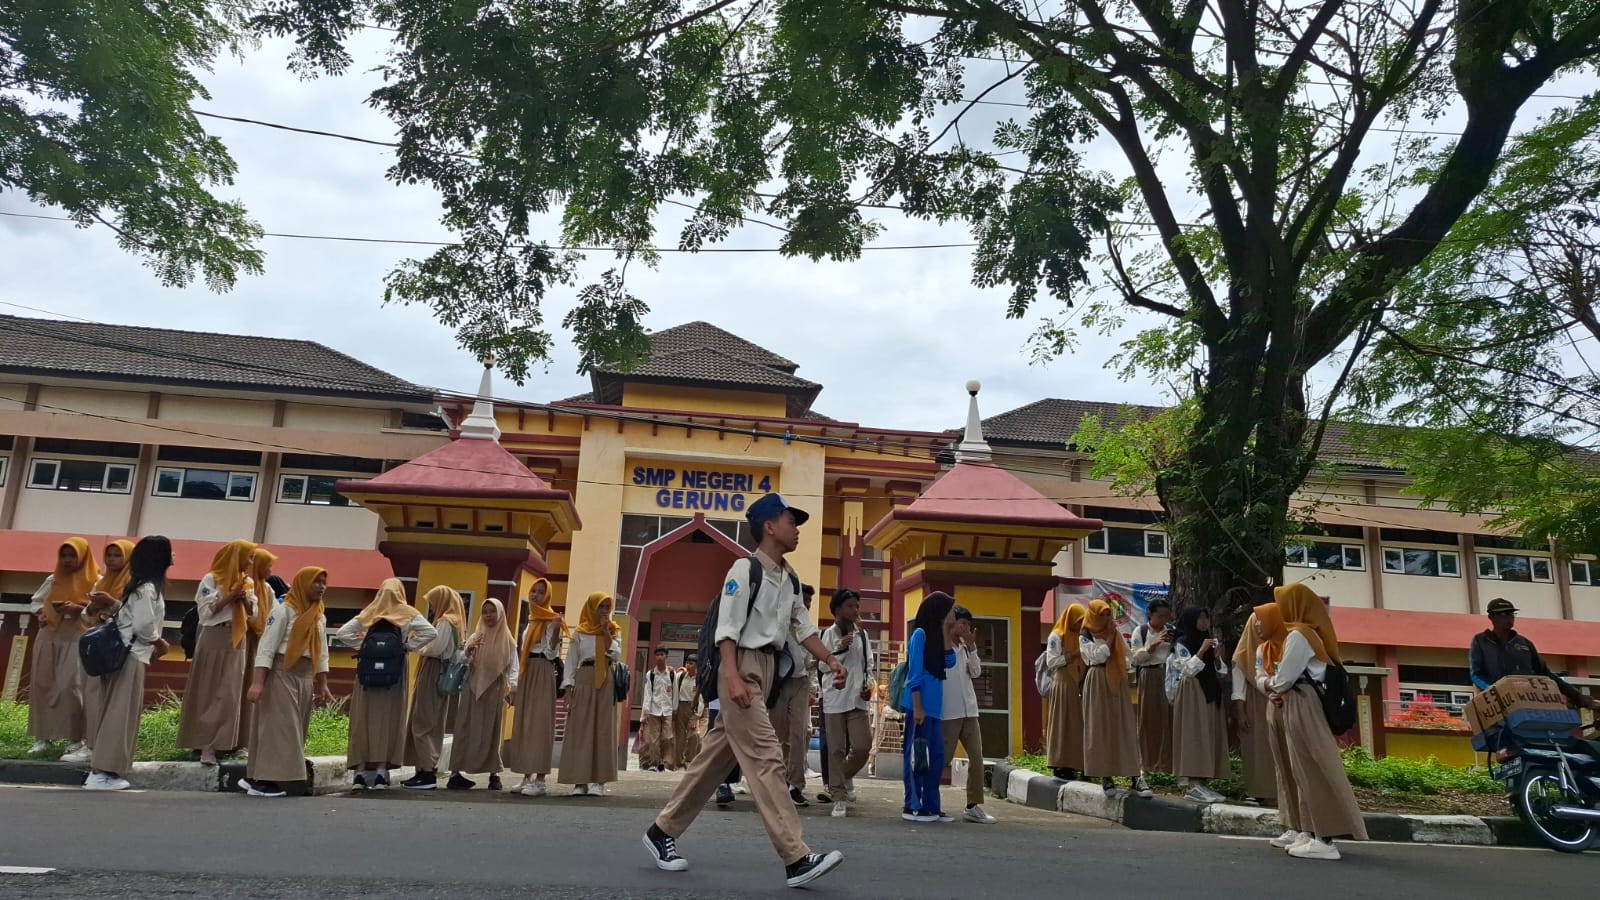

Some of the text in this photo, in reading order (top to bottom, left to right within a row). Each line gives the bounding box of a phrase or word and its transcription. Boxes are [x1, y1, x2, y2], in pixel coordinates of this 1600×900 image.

[633, 466, 772, 492] SMP NEGERI 4
[656, 489, 745, 511] GERUNG
[1528, 678, 1549, 691] ES
